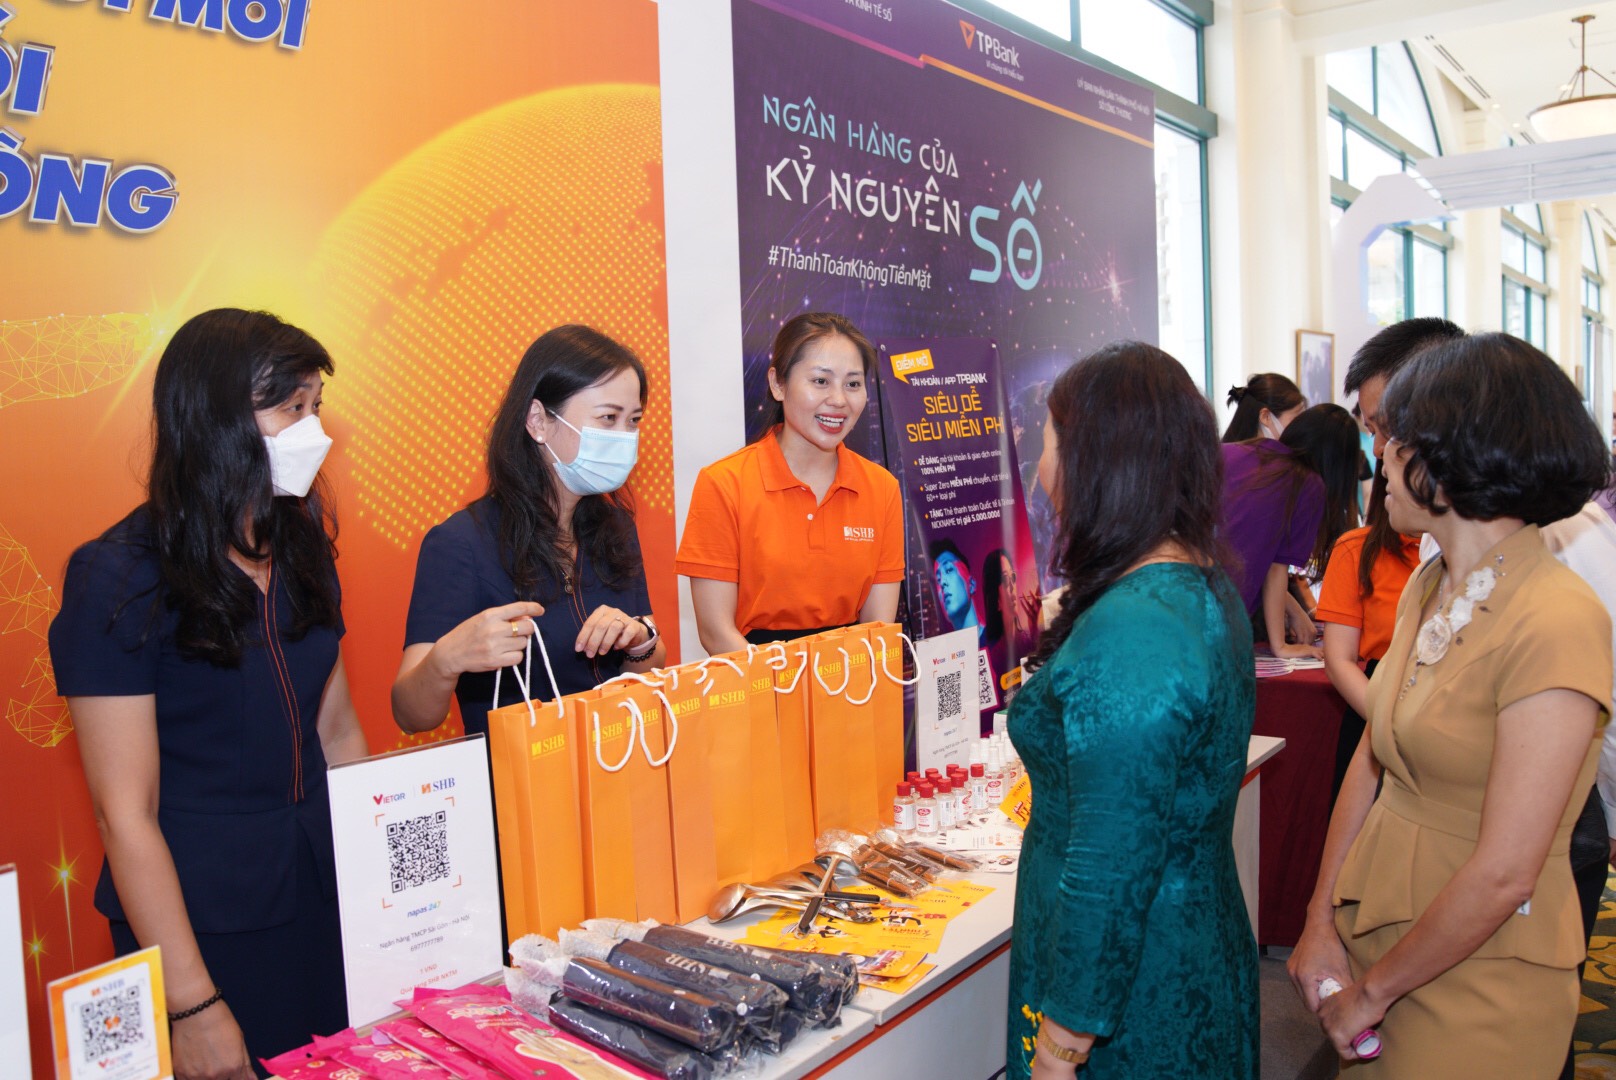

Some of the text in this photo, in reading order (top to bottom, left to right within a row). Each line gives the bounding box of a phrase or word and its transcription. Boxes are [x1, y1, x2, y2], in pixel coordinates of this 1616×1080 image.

[976, 30, 1020, 68] TPBank
[763, 93, 959, 178] NGÂN HÀNG CỦA
[766, 144, 961, 237] KỶ NGUYÊN
[968, 178, 1043, 291] SỐ
[768, 244, 932, 290] #ThanhToánKhôngTiềnMặt
[944, 376, 956, 384] APP
[956, 372, 988, 384] TPBANK
[924, 386, 982, 414] SIÊU DỄ
[906, 418, 942, 442] SIÊU
[944, 411, 982, 439] MIỄN
[853, 528, 874, 538] SHB
[824, 662, 842, 675] SHB
[752, 678, 771, 691] SHB
[721, 690, 746, 704] SHB
[681, 698, 700, 713] SHB
[644, 708, 658, 723] HB
[602, 722, 622, 739] SHB
[542, 734, 564, 753] SHB
[433, 778, 455, 792] SHB
[408, 906, 427, 918] napas
[411, 928, 427, 938] TMCP
